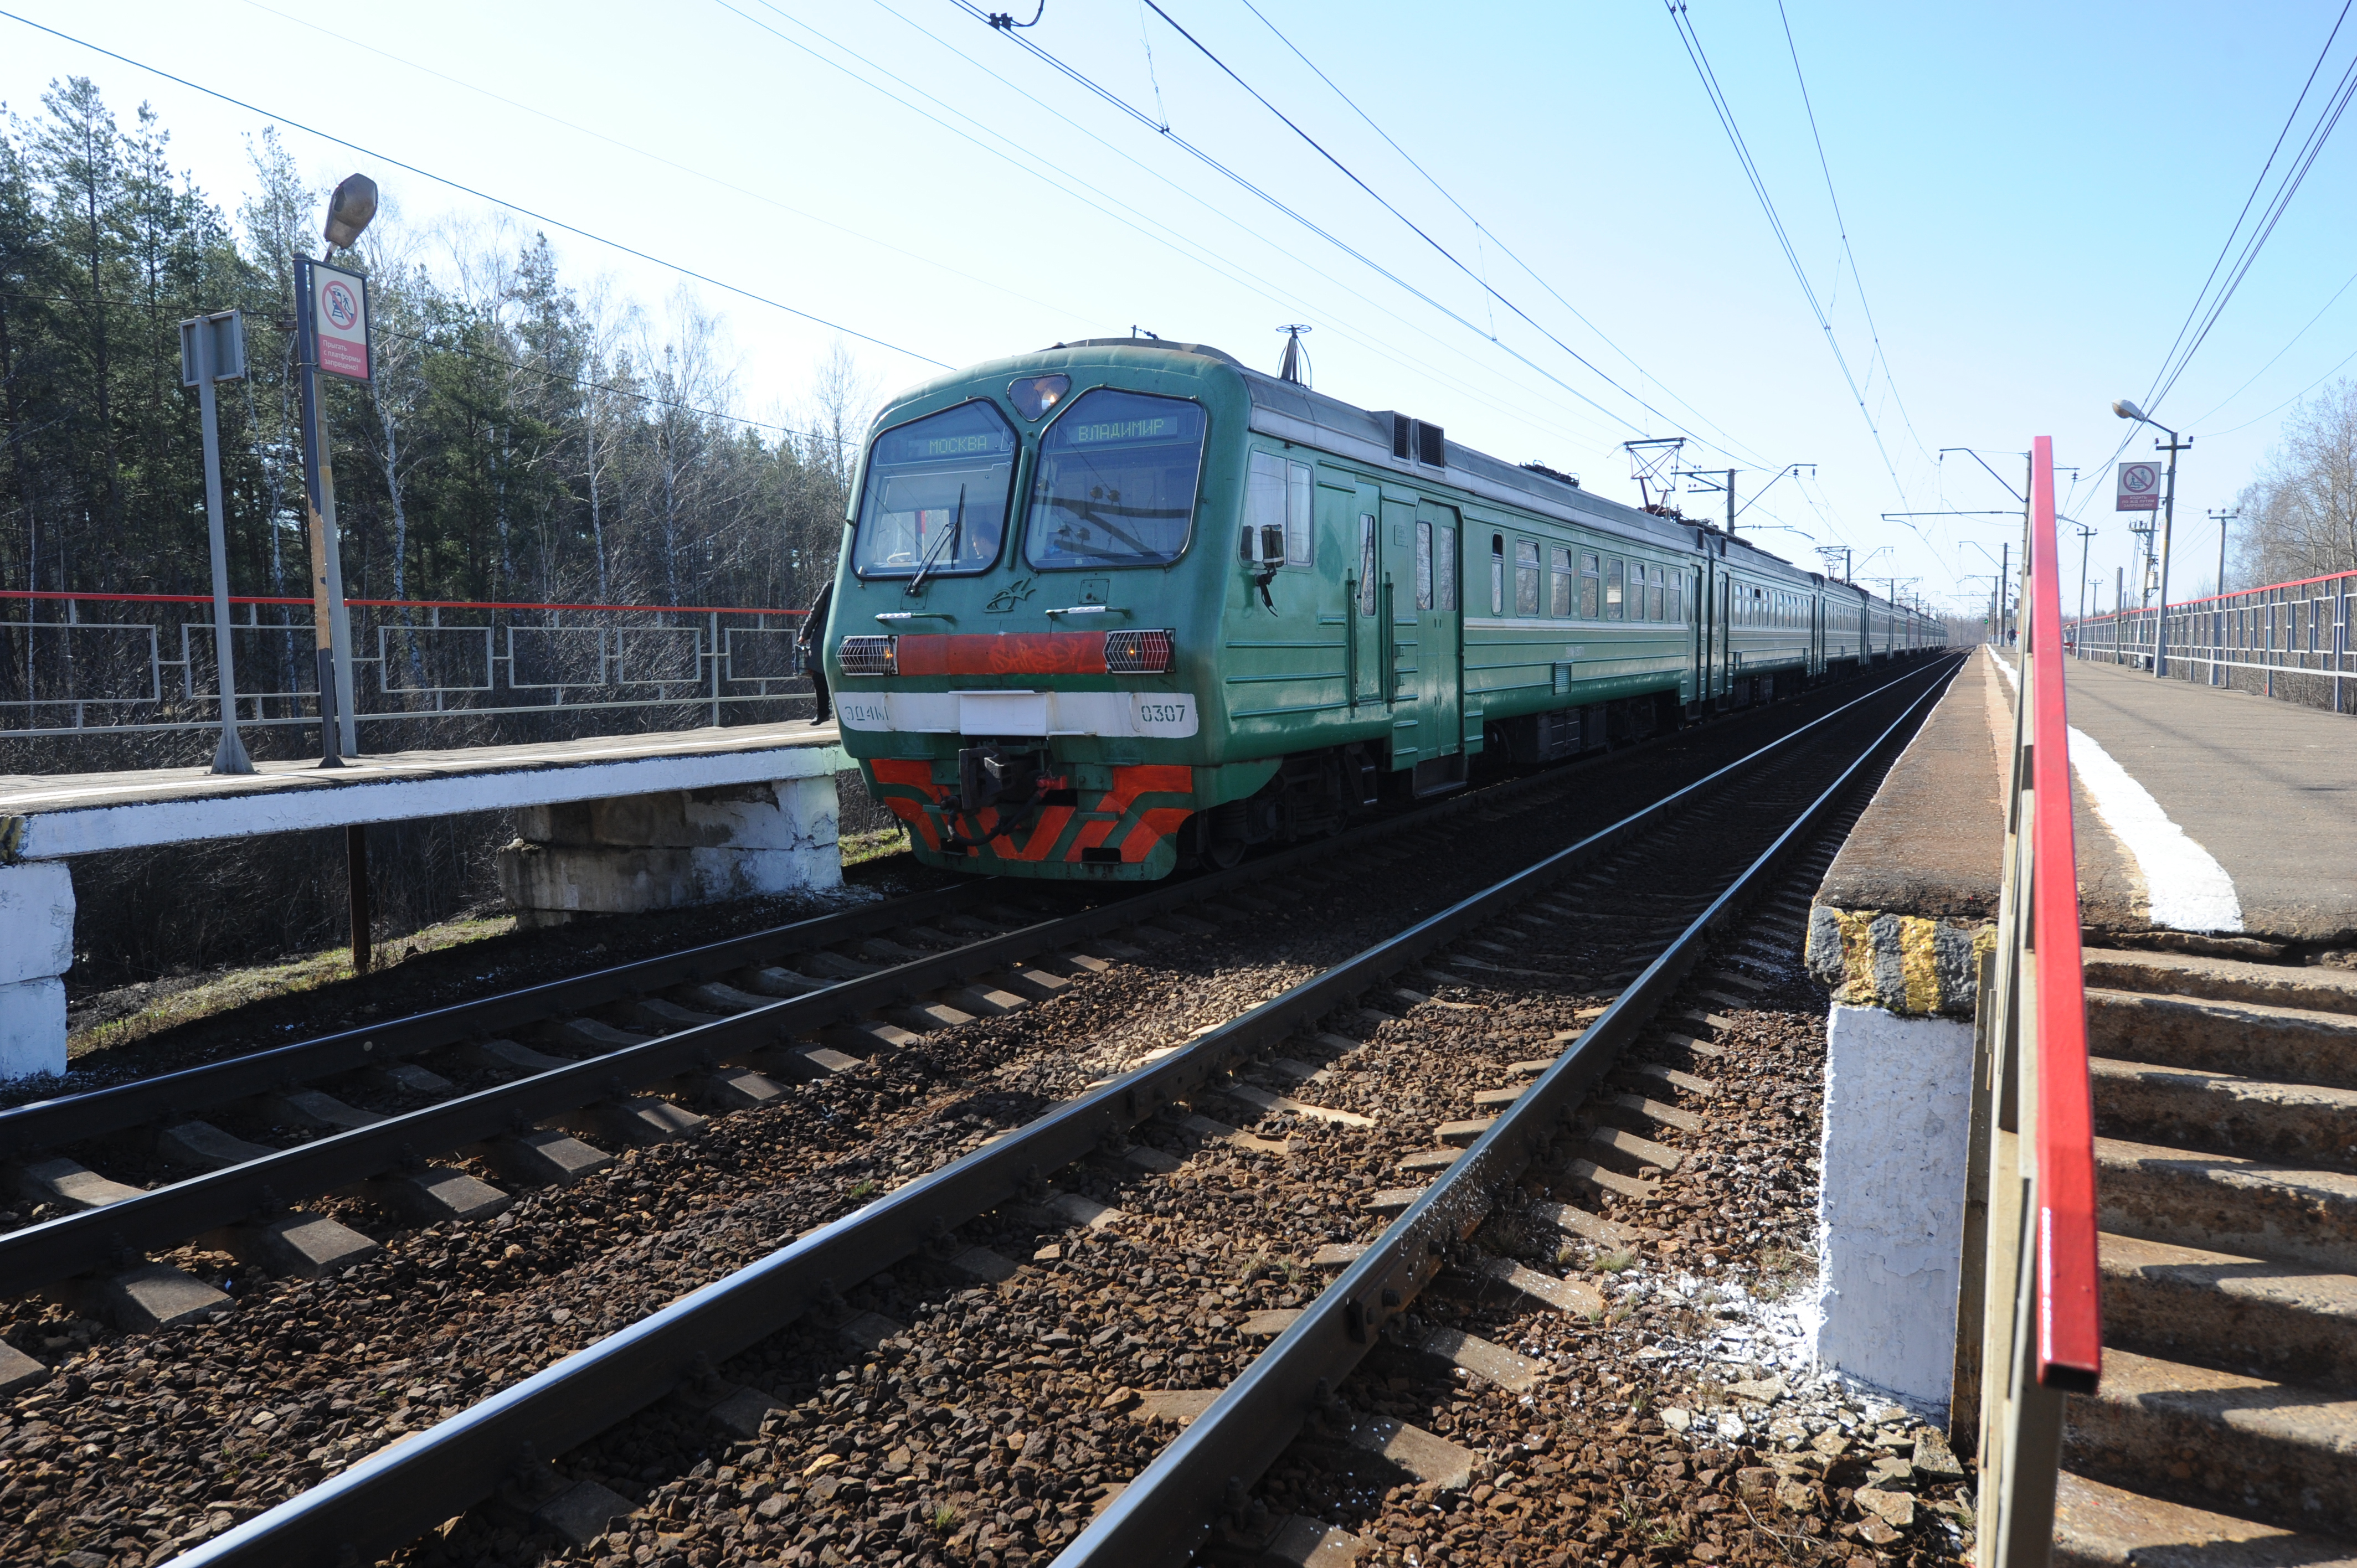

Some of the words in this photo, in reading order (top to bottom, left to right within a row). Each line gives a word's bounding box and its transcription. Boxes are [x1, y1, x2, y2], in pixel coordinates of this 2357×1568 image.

[323, 339, 347, 352] Прыгать
[327, 350, 361, 363] платформы
[325, 359, 358, 371] запрещено!
[1079, 419, 1164, 441] ВЛАДИМИР
[930, 435, 986, 454] МОСКВА
[845, 706, 889, 721] ЭД4М
[1141, 705, 1185, 722] 0307
